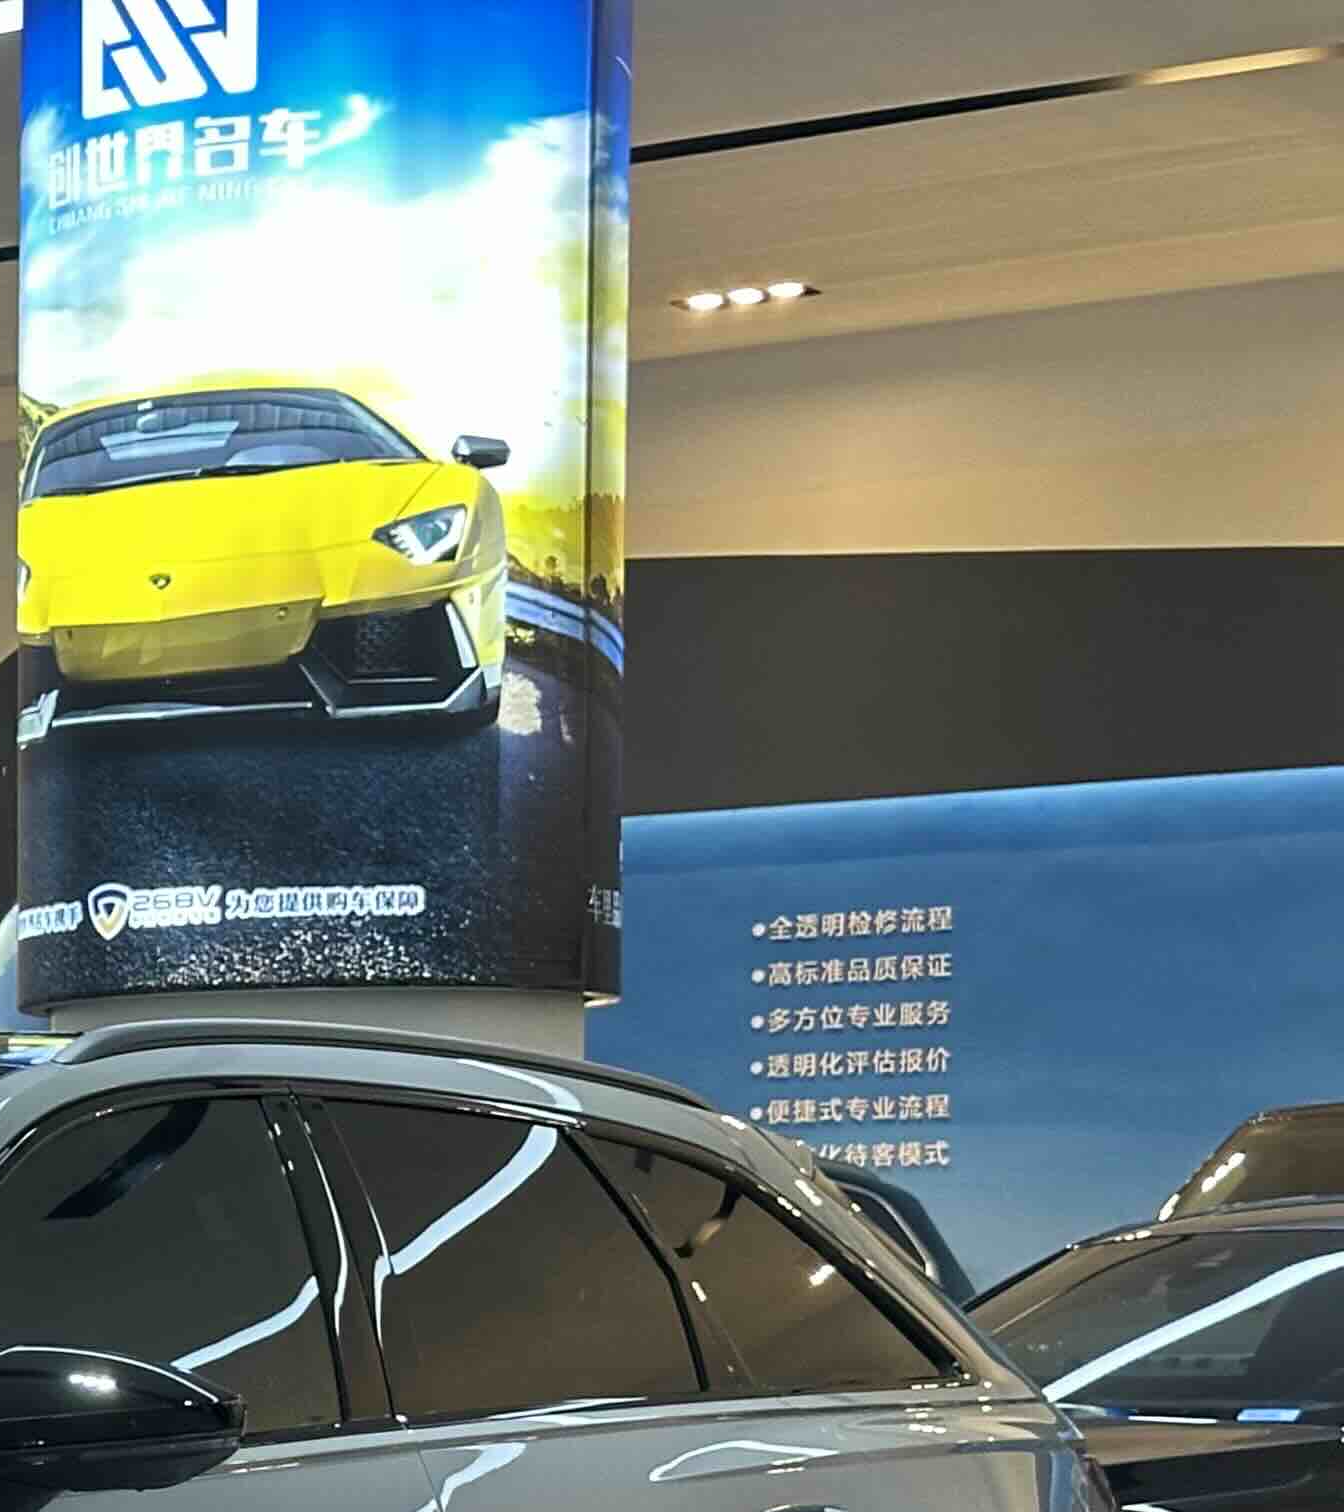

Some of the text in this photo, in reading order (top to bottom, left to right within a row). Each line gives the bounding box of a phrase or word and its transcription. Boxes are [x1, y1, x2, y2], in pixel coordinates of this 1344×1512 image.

[48, 107, 321, 209] 创世界名车
[767, 906, 953, 941] 全透明检修流程
[767, 953, 953, 987] 高标准品质保证
[767, 1000, 952, 1034] 多方位专业服务
[767, 1047, 952, 1079] 透明化评估报价
[767, 1094, 952, 1125] 便捷式专业流程
[811, 1140, 952, 1168] 化待客模式
